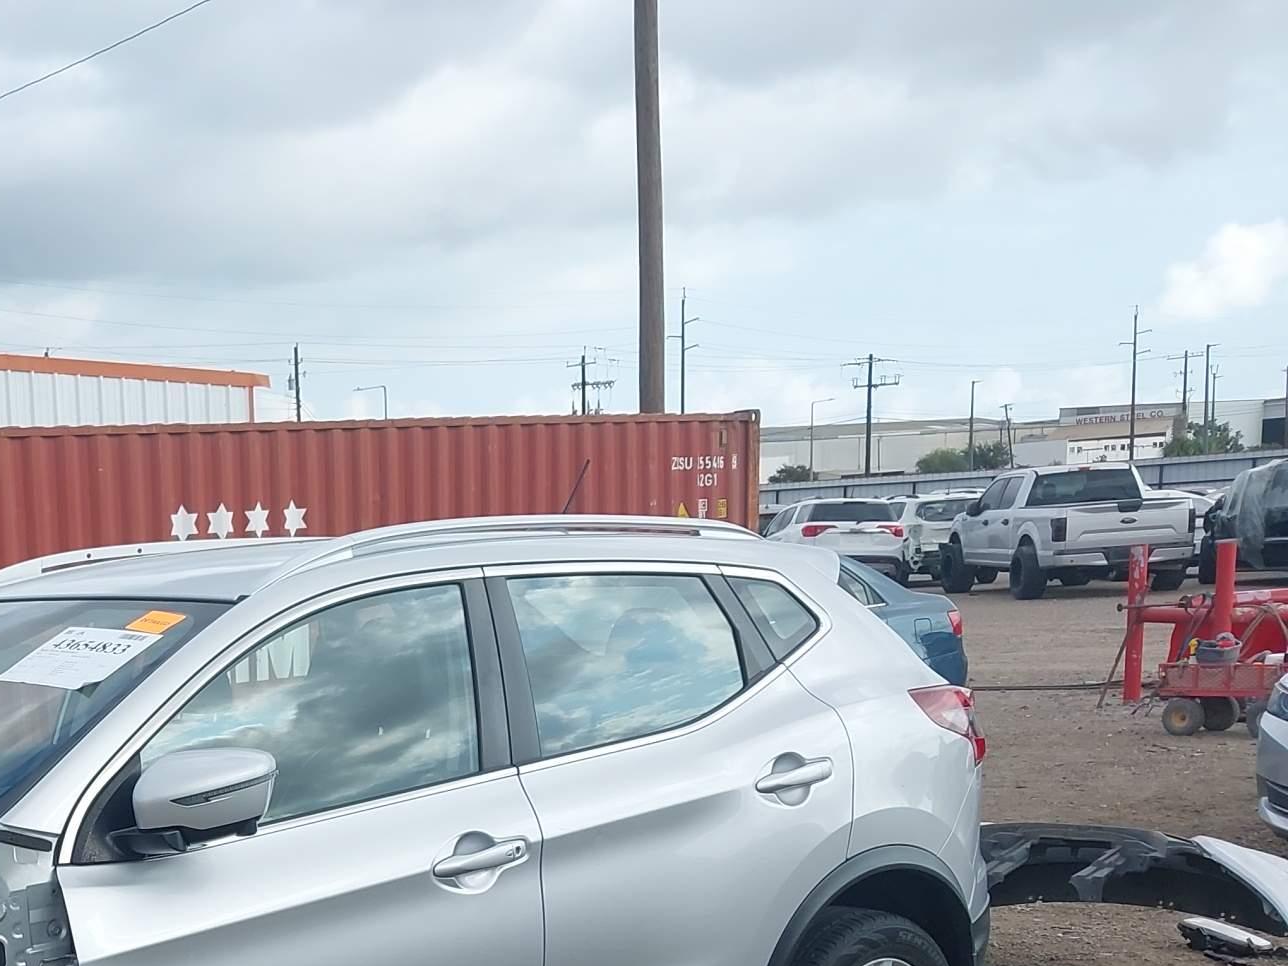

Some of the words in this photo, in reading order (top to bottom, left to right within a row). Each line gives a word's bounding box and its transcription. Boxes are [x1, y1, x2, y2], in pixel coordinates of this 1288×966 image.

[1075, 415, 1116, 425] WESTERN
[1120, 411, 1146, 422] STEL
[52, 638, 132, 655] 43654833
